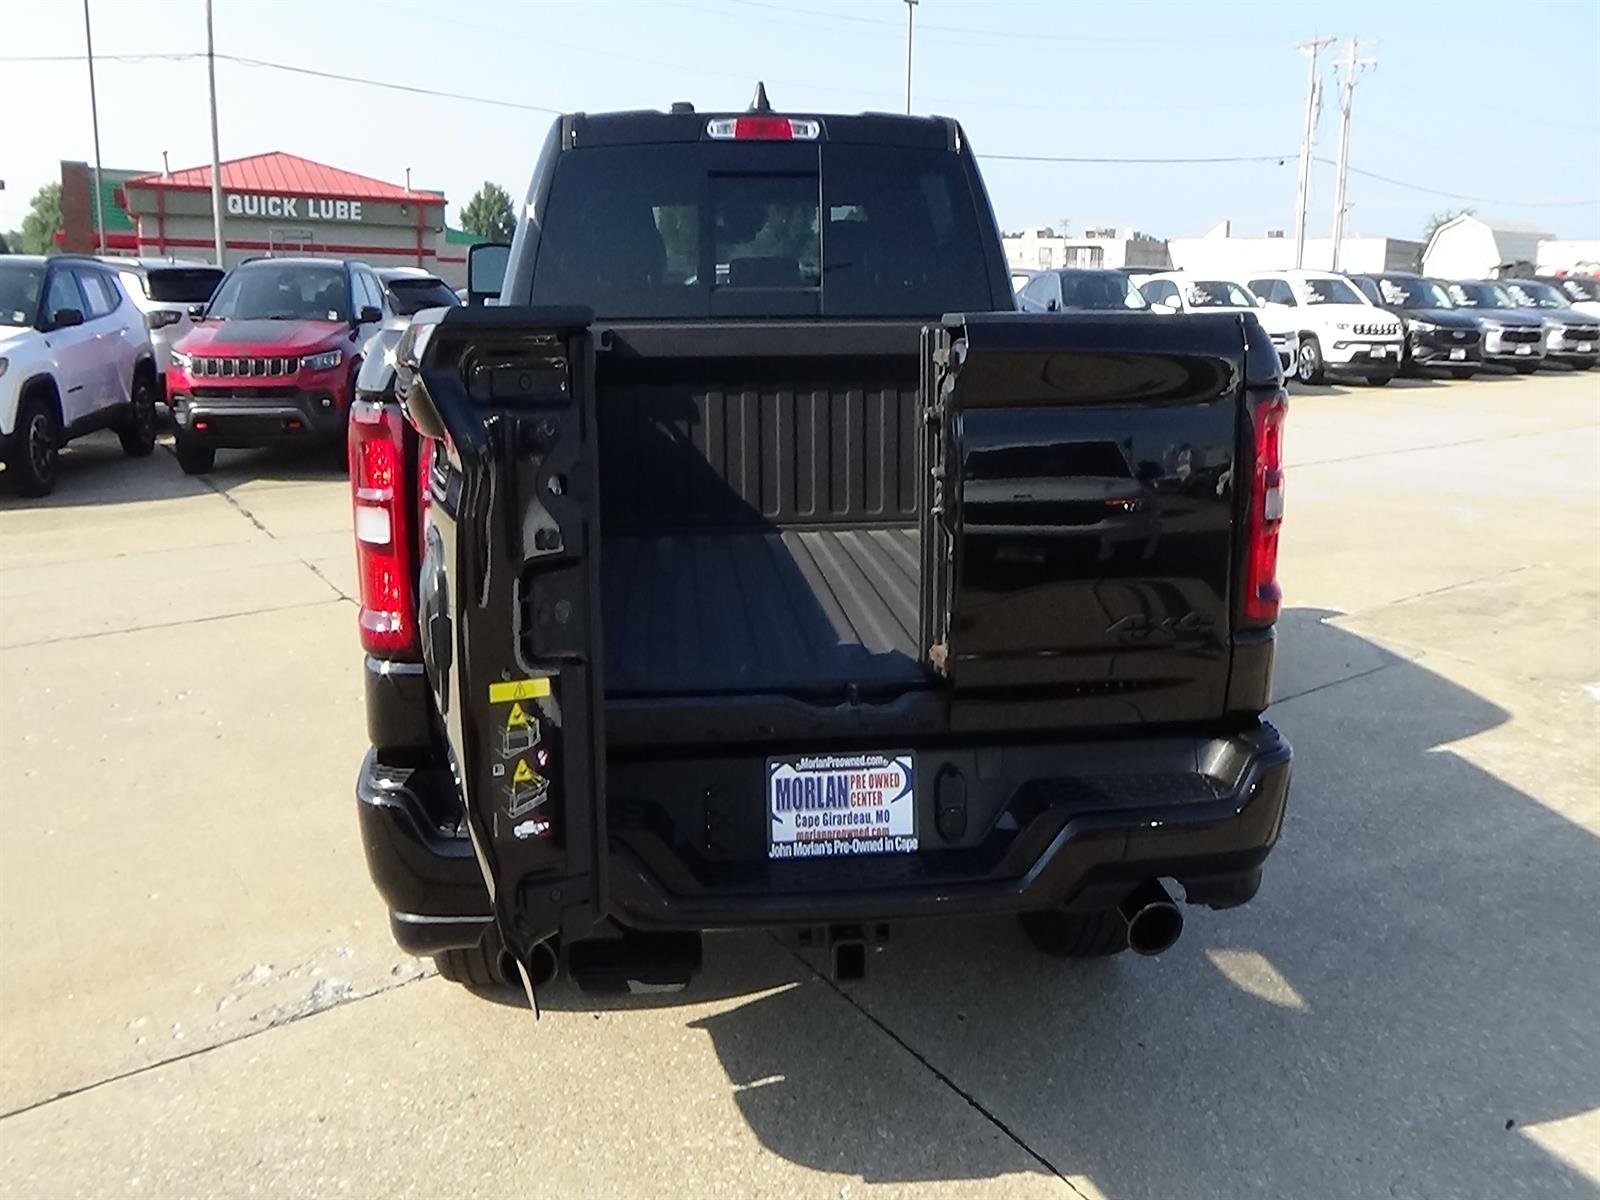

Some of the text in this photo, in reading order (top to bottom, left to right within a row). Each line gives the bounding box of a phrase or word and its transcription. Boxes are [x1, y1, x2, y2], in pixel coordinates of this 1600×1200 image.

[227, 194, 362, 221] QUICK LUBE
[850, 772, 900, 790] PRE OWNED
[775, 775, 849, 812] MORLAN
[850, 791, 883, 808] CENTER
[795, 809, 890, 829] Cape Girardeau, MO
[768, 836, 919, 858] John Morlan's Pre-Owned in Cape
